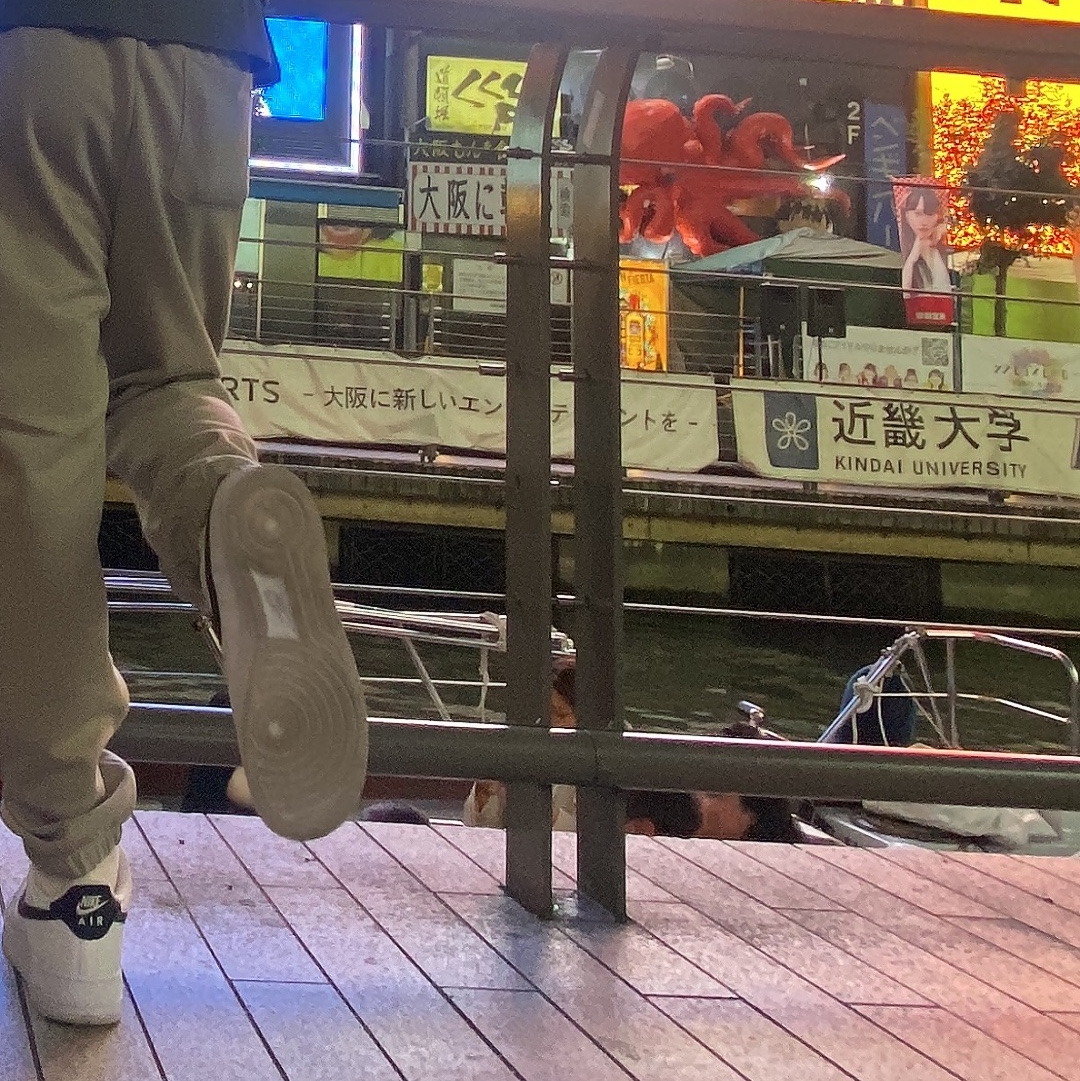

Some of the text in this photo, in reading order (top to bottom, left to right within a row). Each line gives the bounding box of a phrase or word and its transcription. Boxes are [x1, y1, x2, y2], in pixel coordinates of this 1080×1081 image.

[831, 399, 1030, 453] 近畿大学
[835, 455, 1027, 479] KINDAI UNIVERSITY
[78, 915, 104, 926] AIR
